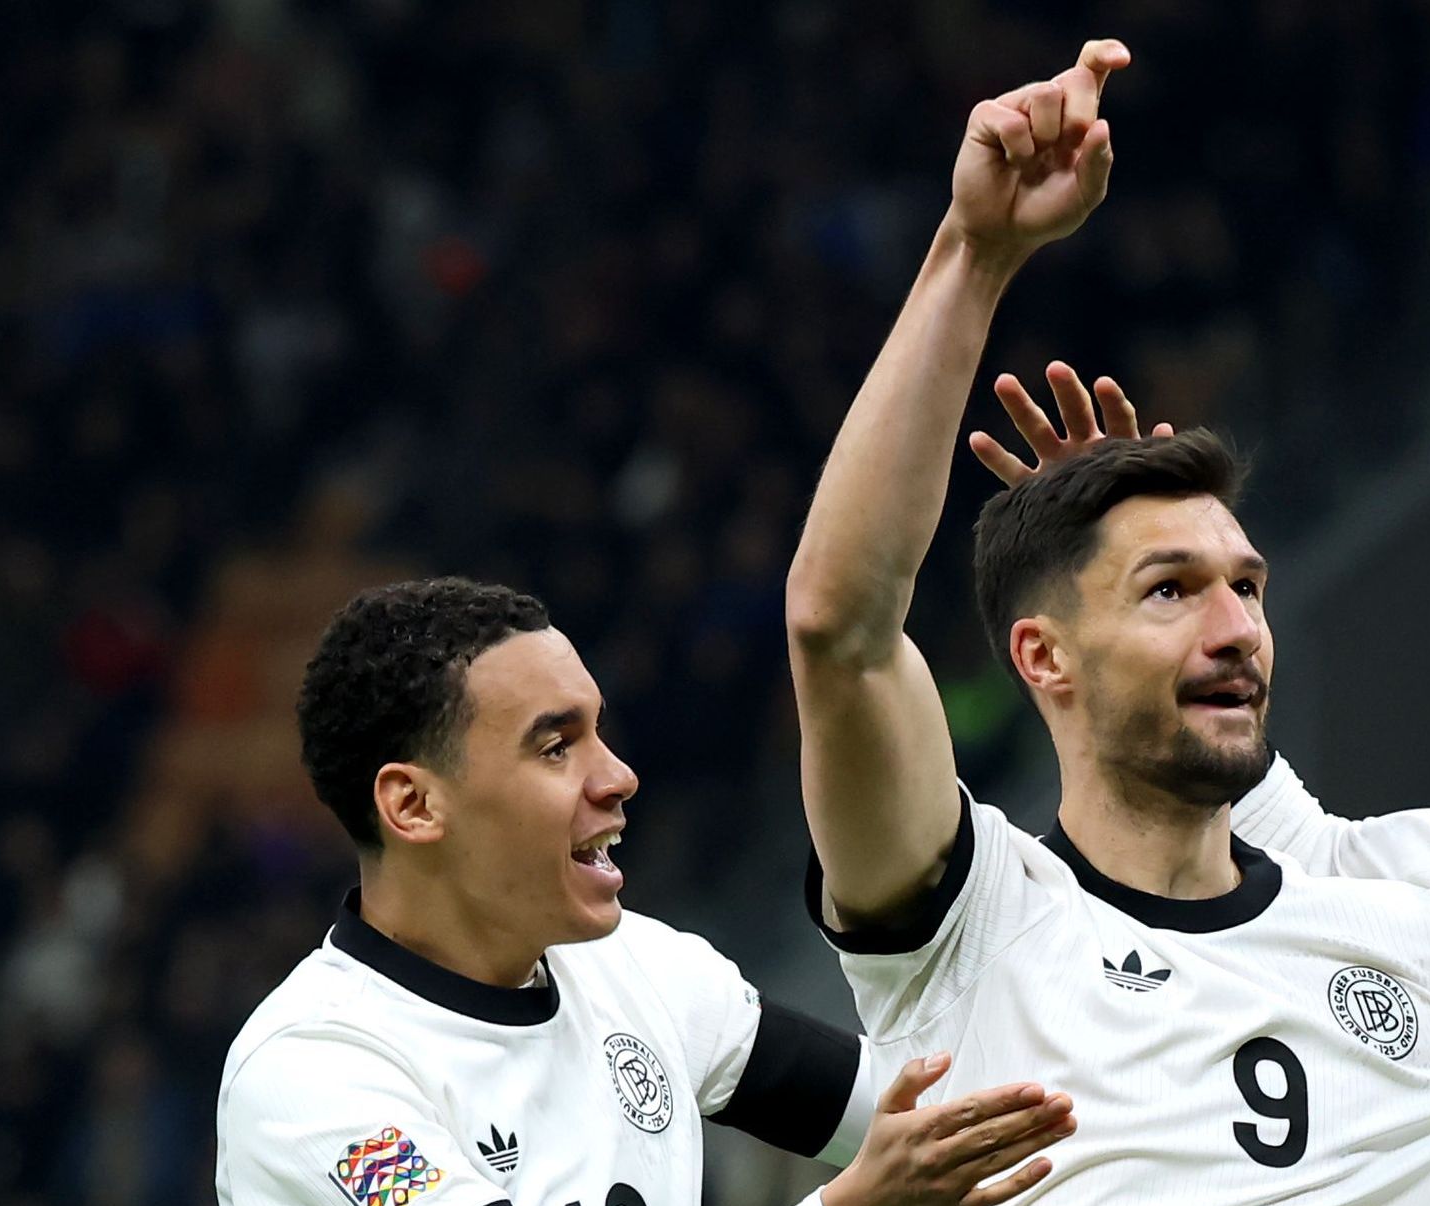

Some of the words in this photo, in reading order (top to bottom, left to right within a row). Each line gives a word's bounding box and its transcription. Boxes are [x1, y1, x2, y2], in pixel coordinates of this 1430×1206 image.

[1334, 975, 1369, 1044] DEUTSCHER
[1350, 970, 1414, 1048] FUSSBALL-BUND
[1232, 1036, 1309, 1168] 9
